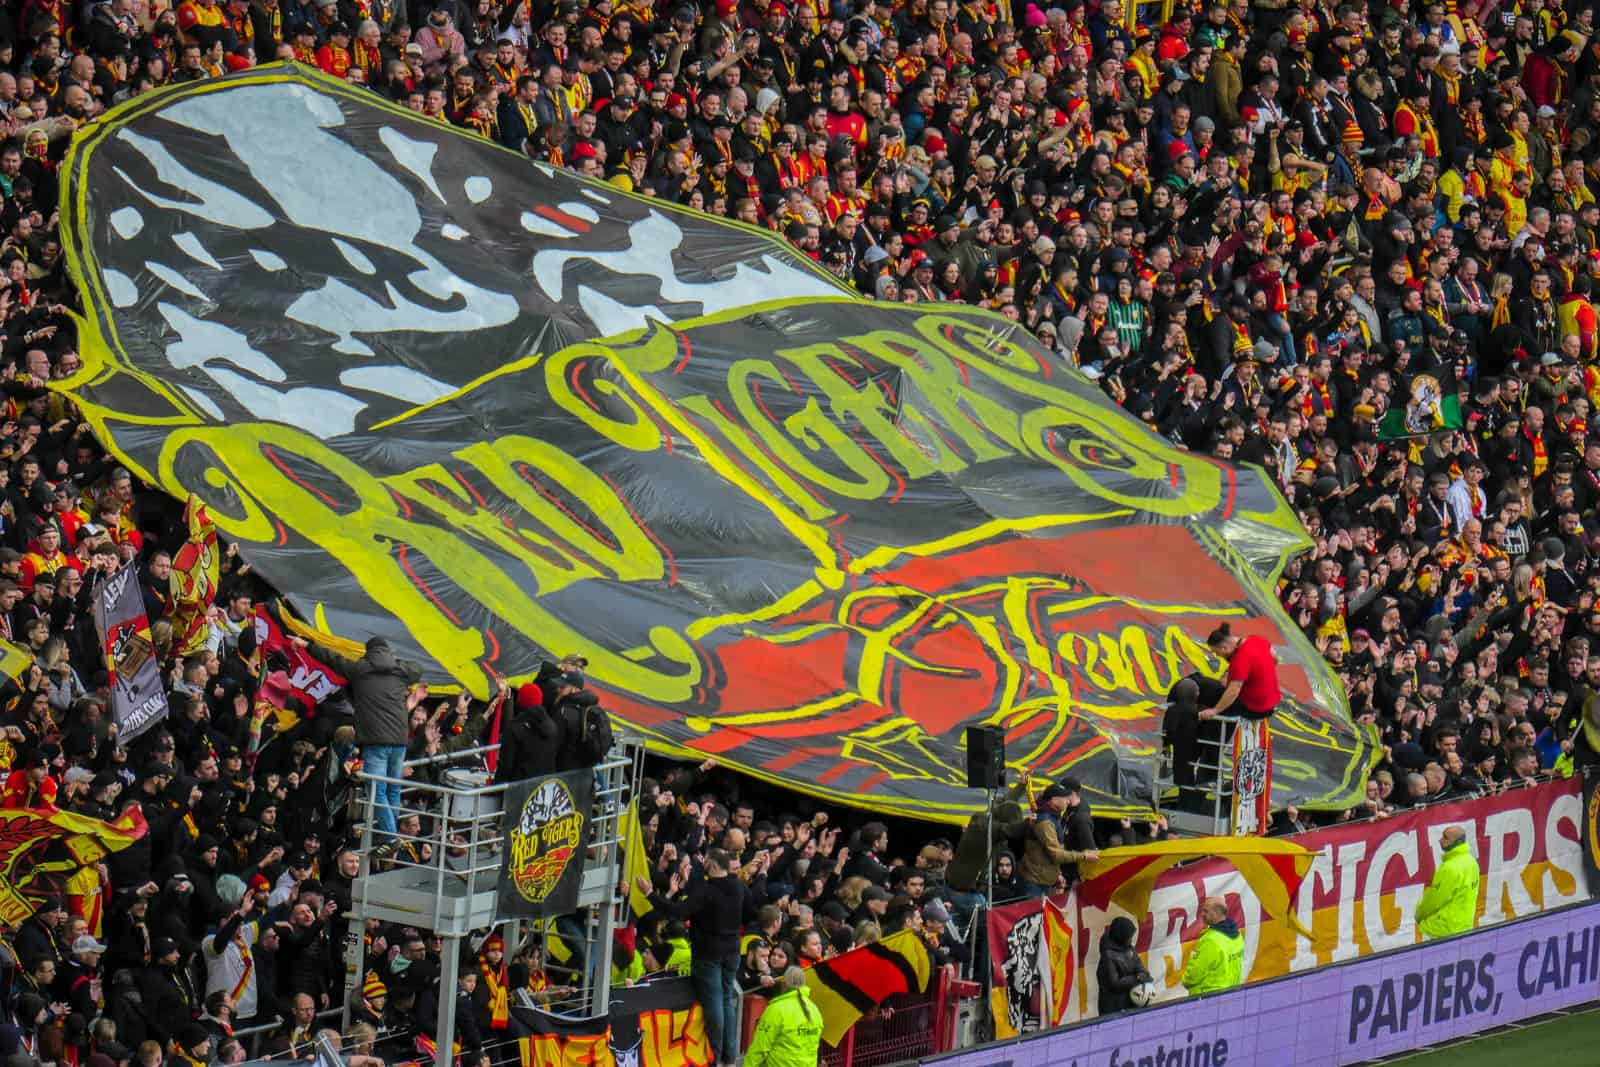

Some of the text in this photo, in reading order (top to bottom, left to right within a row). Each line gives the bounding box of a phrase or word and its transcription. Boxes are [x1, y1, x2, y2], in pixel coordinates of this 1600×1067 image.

[158, 423, 702, 703] RED
[544, 312, 1223, 580] TIGERS
[511, 812, 584, 875] RED TIGERS
[1349, 952, 1502, 1044] PAPIERS,
